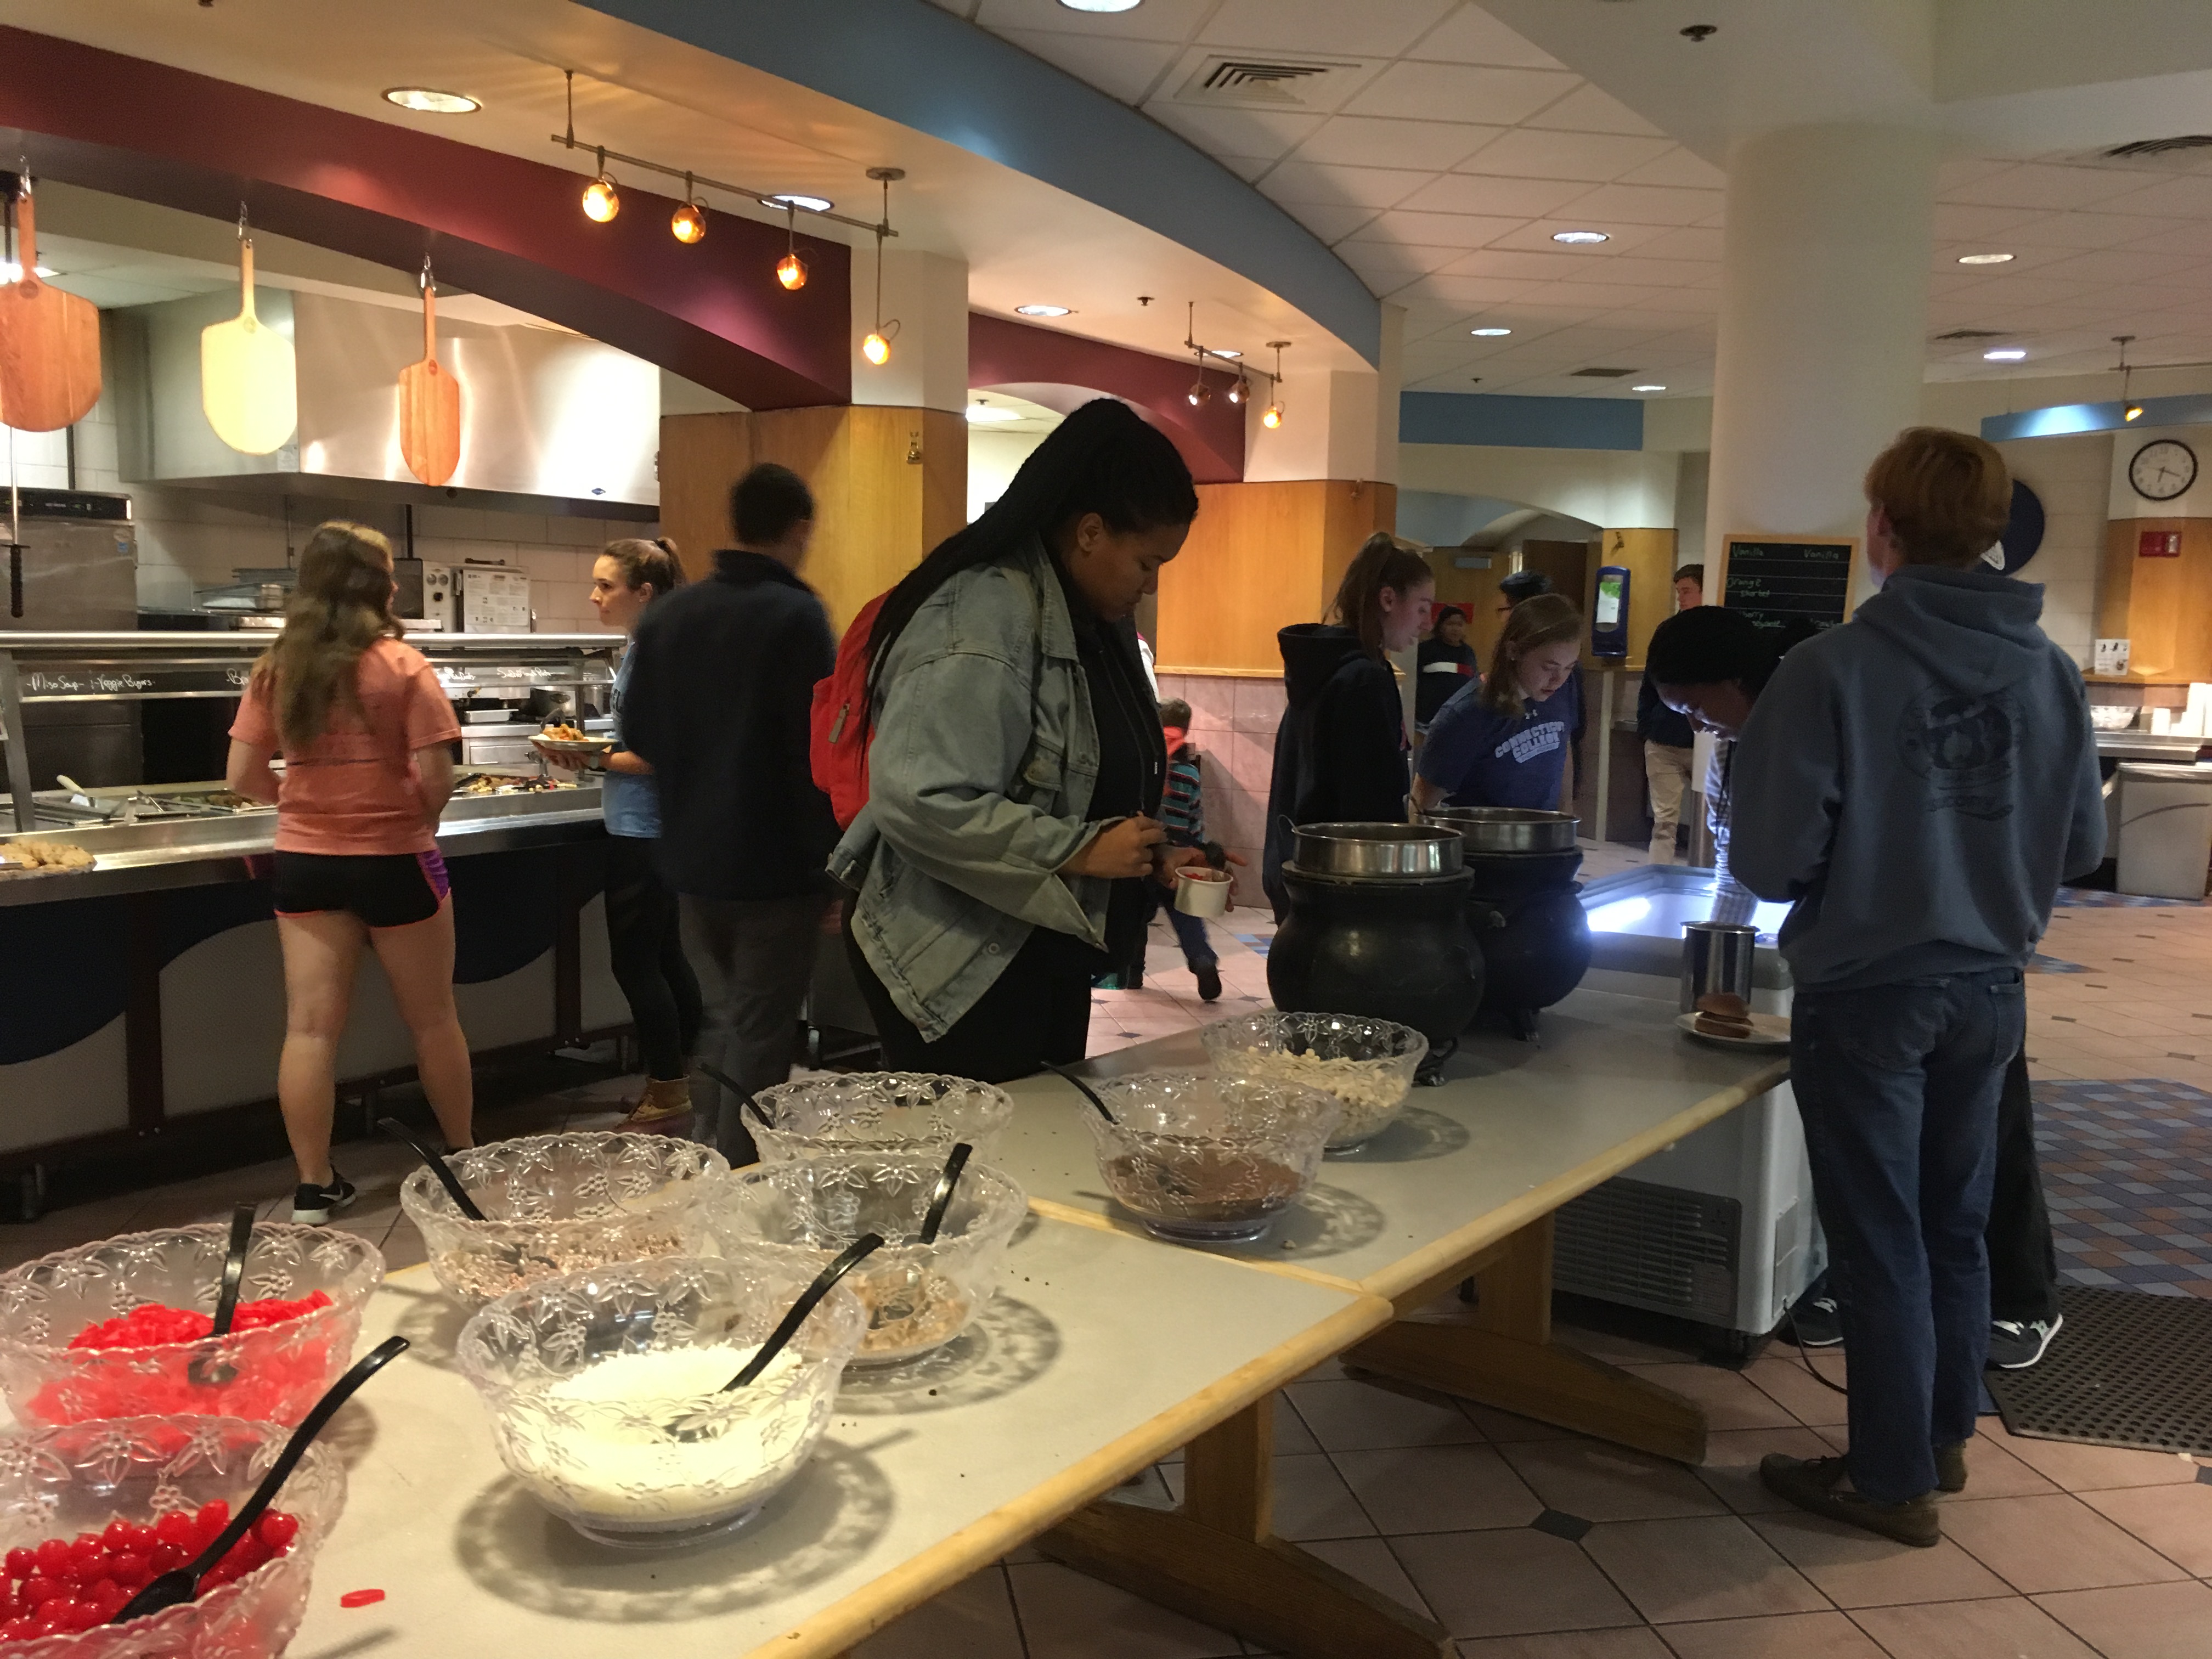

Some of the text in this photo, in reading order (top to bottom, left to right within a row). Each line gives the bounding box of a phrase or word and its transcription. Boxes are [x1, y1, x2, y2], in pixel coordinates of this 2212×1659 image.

[1732, 544, 1764, 557] Vanilla
[1803, 548, 1839, 559] Vanilla
[1726, 577, 1762, 589] Orange
[1513, 732, 1560, 759] COLLEGE
